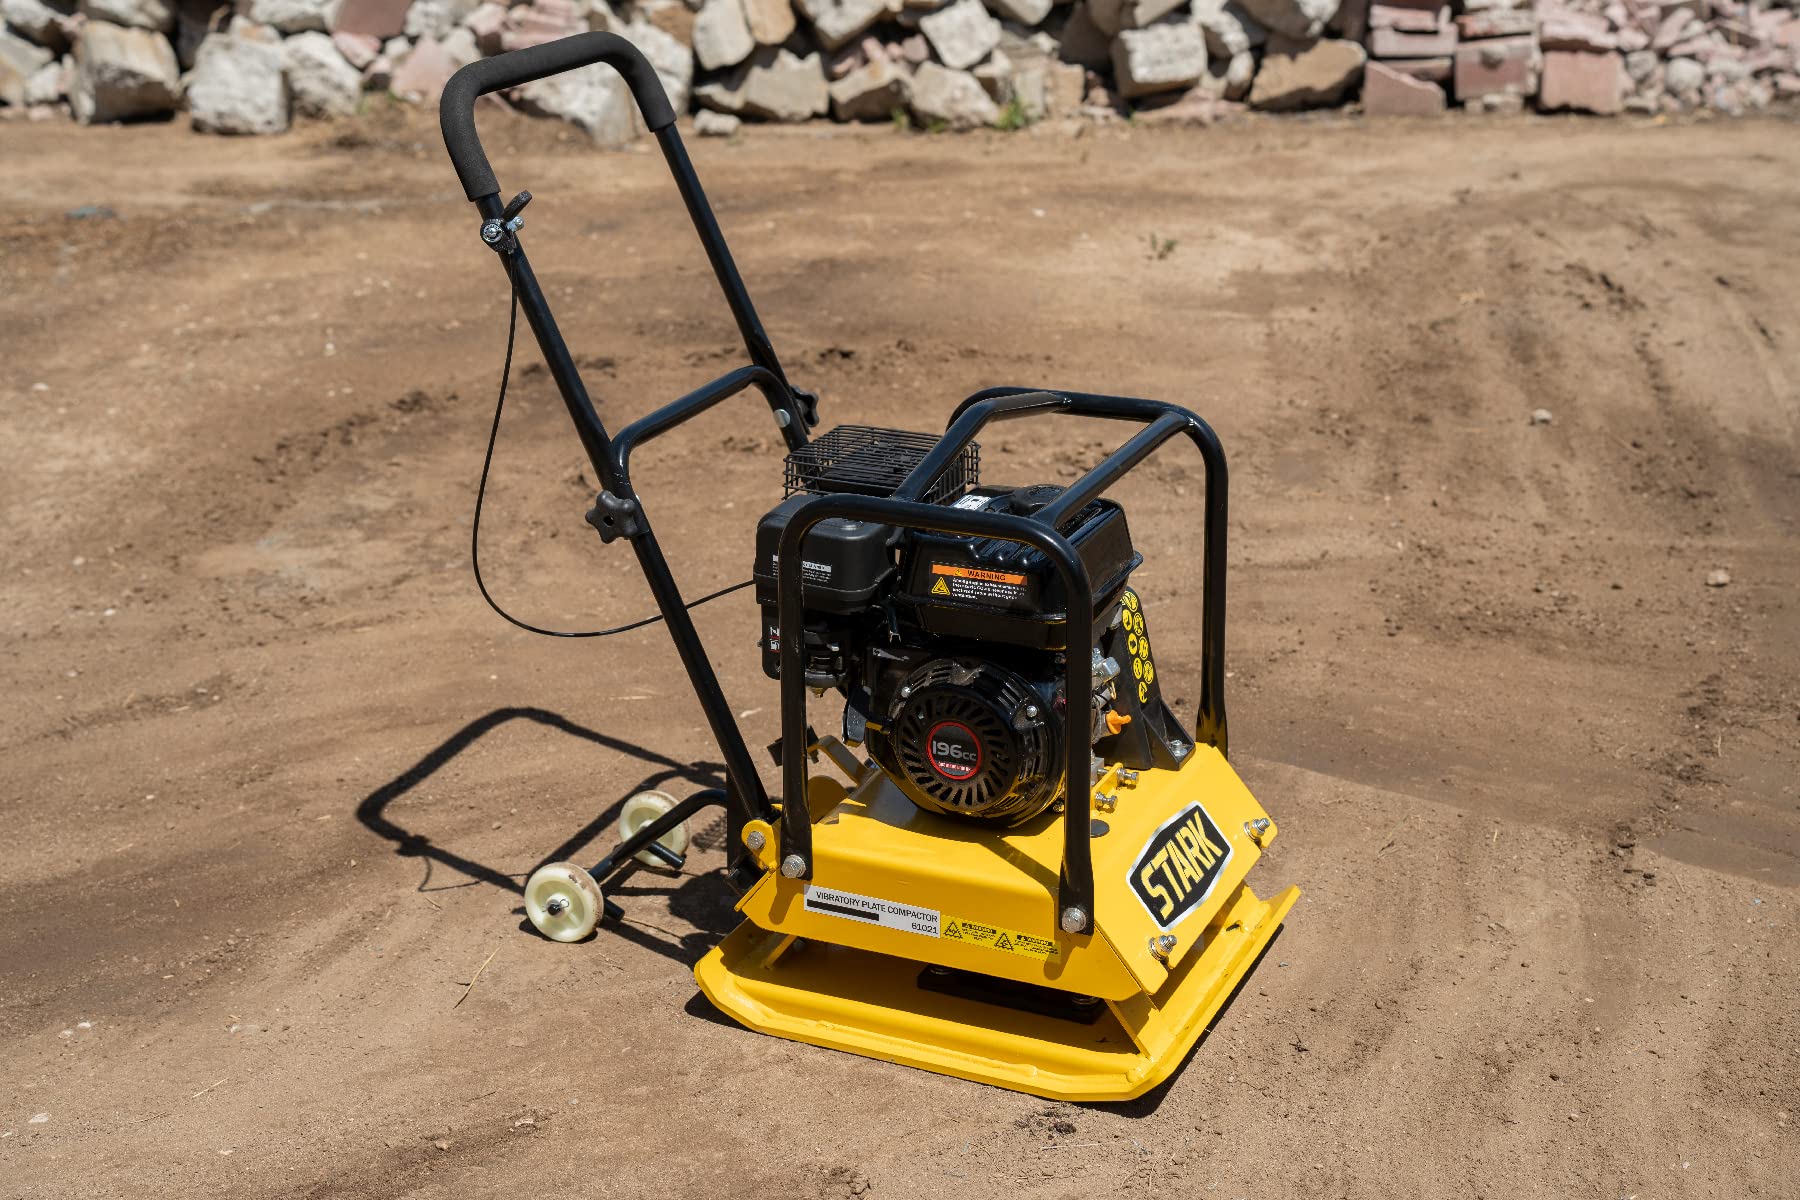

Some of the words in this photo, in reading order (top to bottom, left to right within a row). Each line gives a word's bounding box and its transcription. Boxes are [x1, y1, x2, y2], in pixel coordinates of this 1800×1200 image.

[967, 569, 1006, 581] WARNING
[1141, 810, 1224, 920] STARK
[816, 891, 861, 907] VIBRATORY
[861, 900, 887, 913] PLATE
[887, 905, 938, 923] COMPACTOR
[911, 922, 939, 935] 61021
